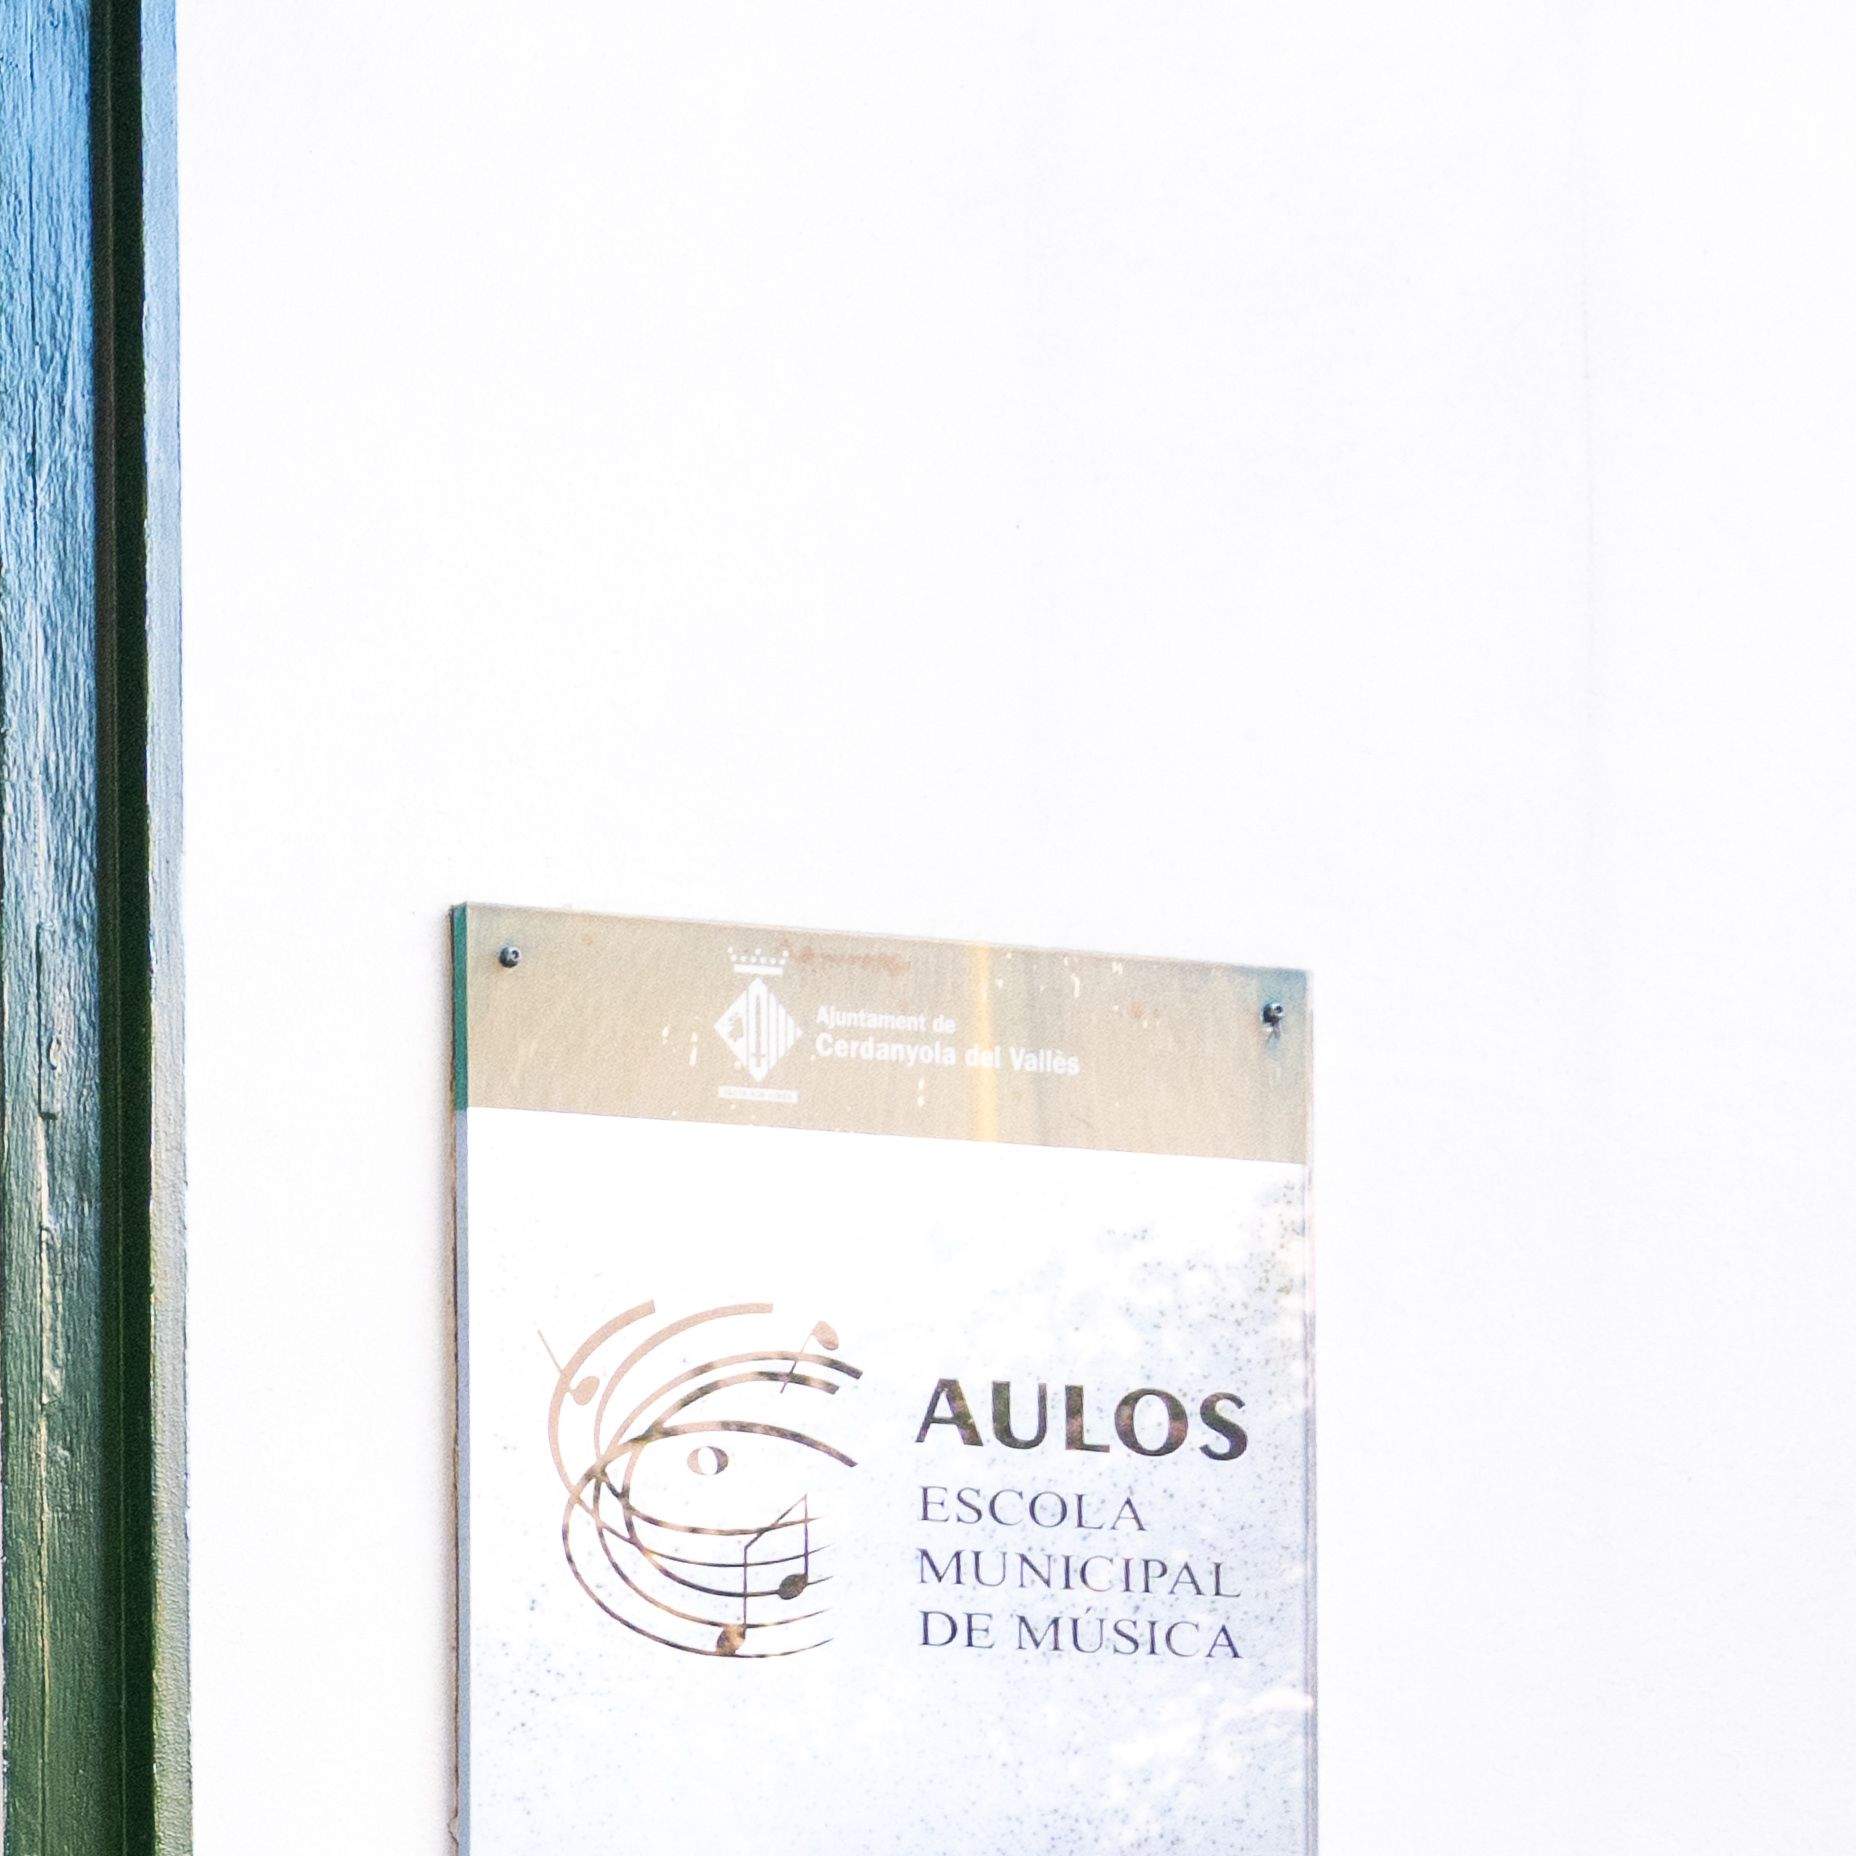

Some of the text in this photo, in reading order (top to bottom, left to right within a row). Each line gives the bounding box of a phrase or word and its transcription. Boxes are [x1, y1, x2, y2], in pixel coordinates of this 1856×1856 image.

[816, 1005, 956, 1034] Ajuntament de
[815, 1032, 1081, 1075] Cerdanyola del Vallès
[915, 1378, 1249, 1462] AULOS
[921, 1486, 1146, 1532] ESCOLA
[919, 1548, 1242, 1598] MUNICIPAL
[920, 1606, 1244, 1659] DE MÚSICA
